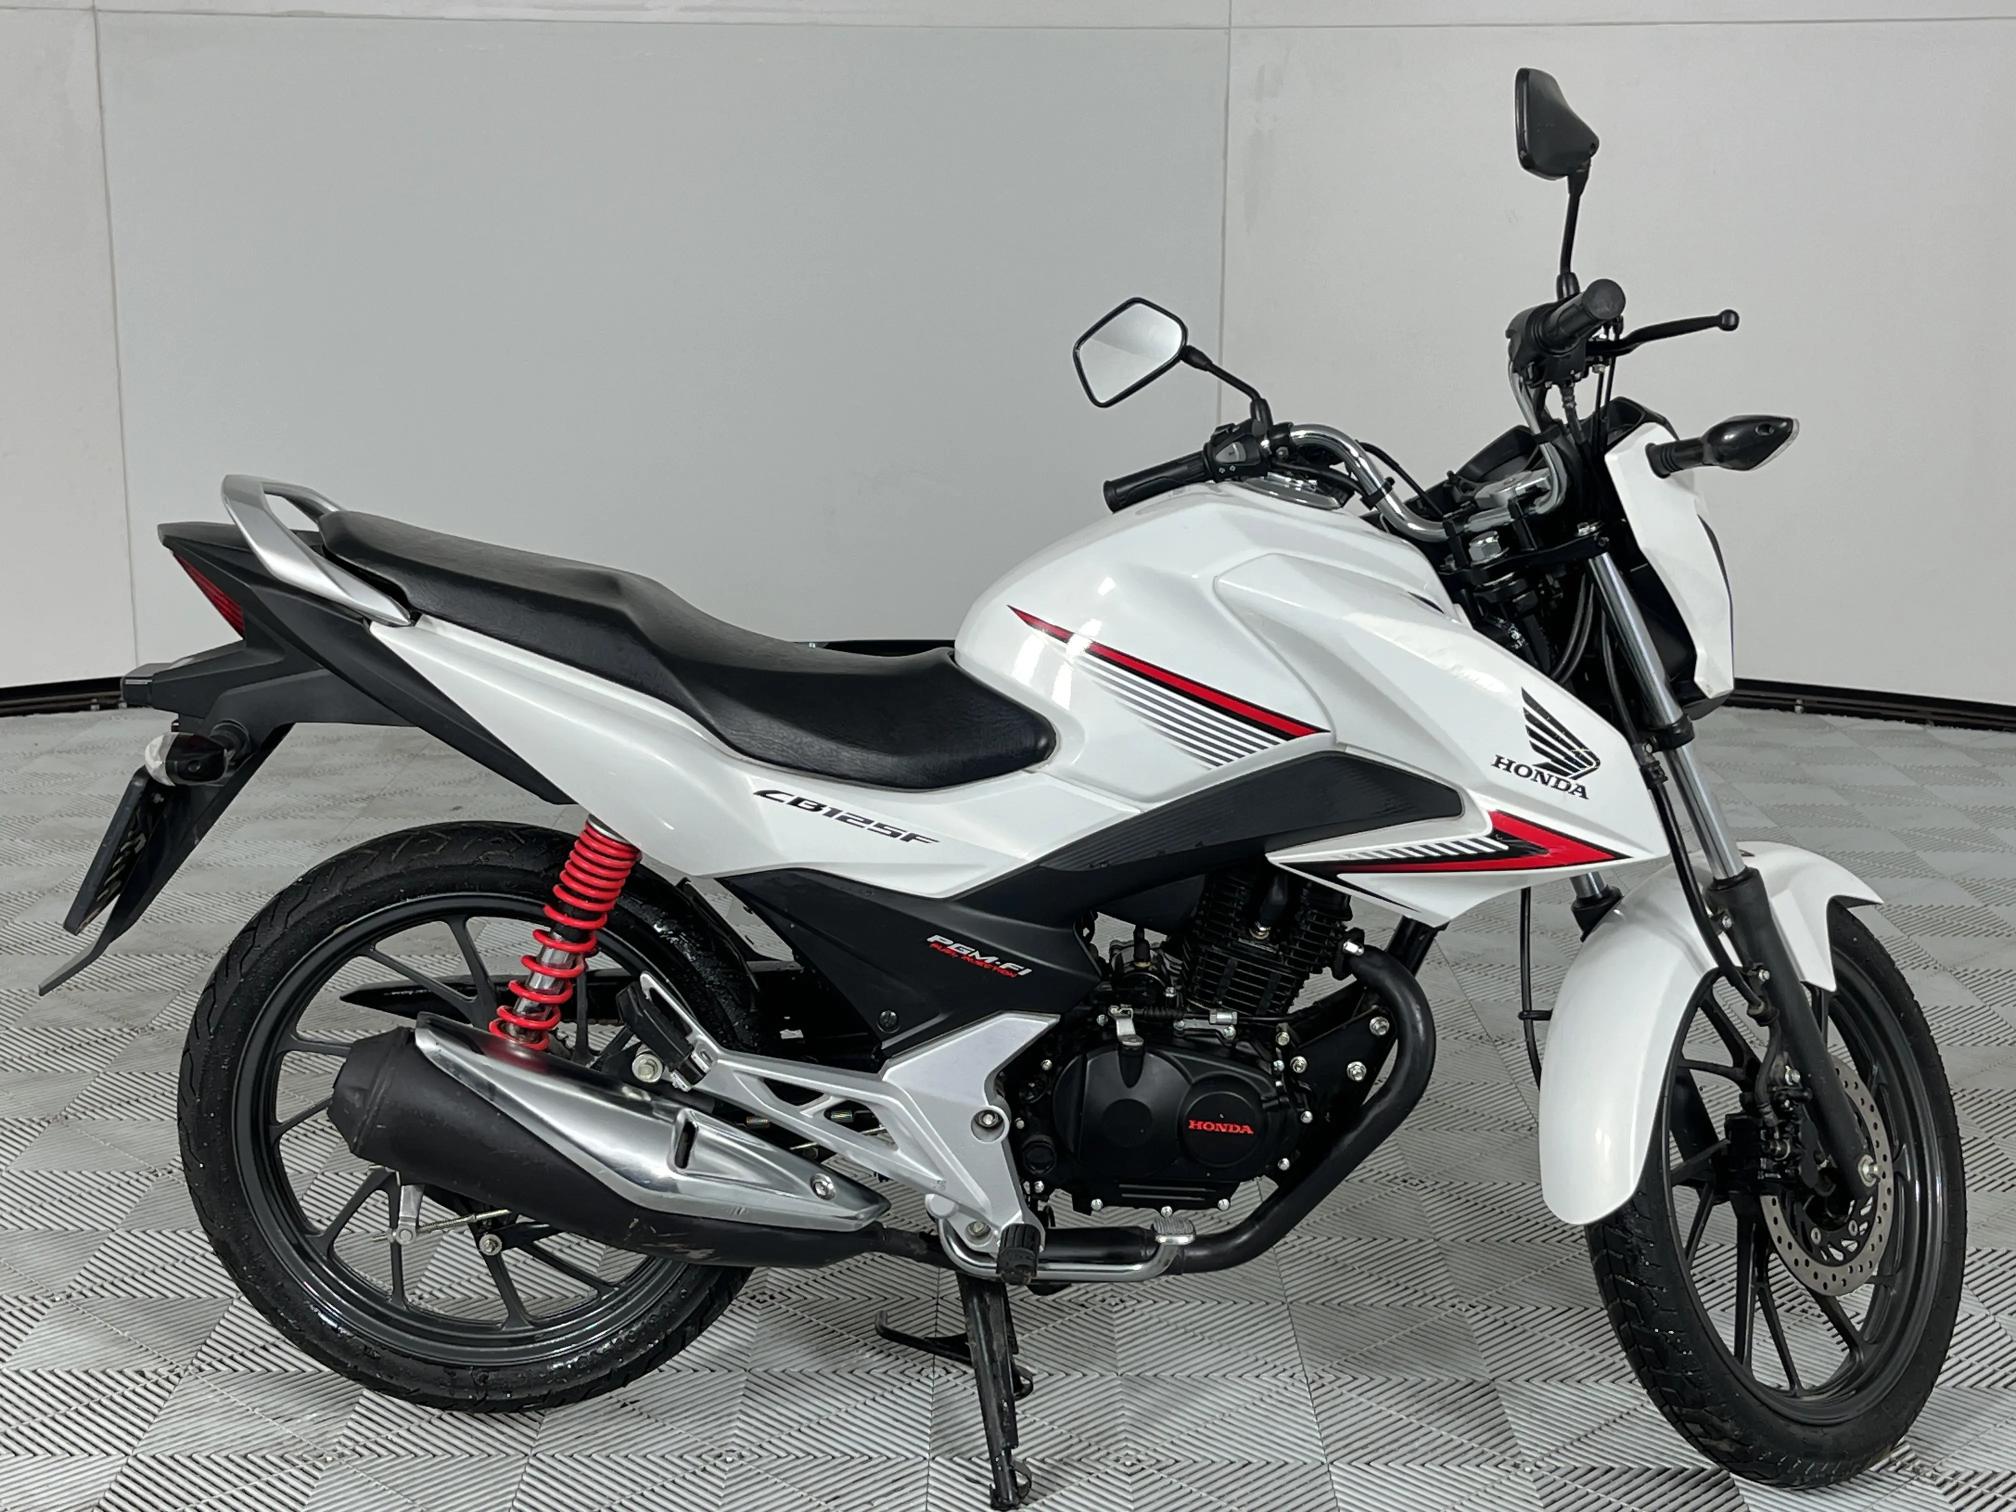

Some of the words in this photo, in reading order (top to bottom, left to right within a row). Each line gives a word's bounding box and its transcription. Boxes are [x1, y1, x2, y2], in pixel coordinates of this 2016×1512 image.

[1490, 754, 1590, 800] HONDA
[752, 789, 941, 844] CB125F
[1187, 1119, 1255, 1135] HONDA
